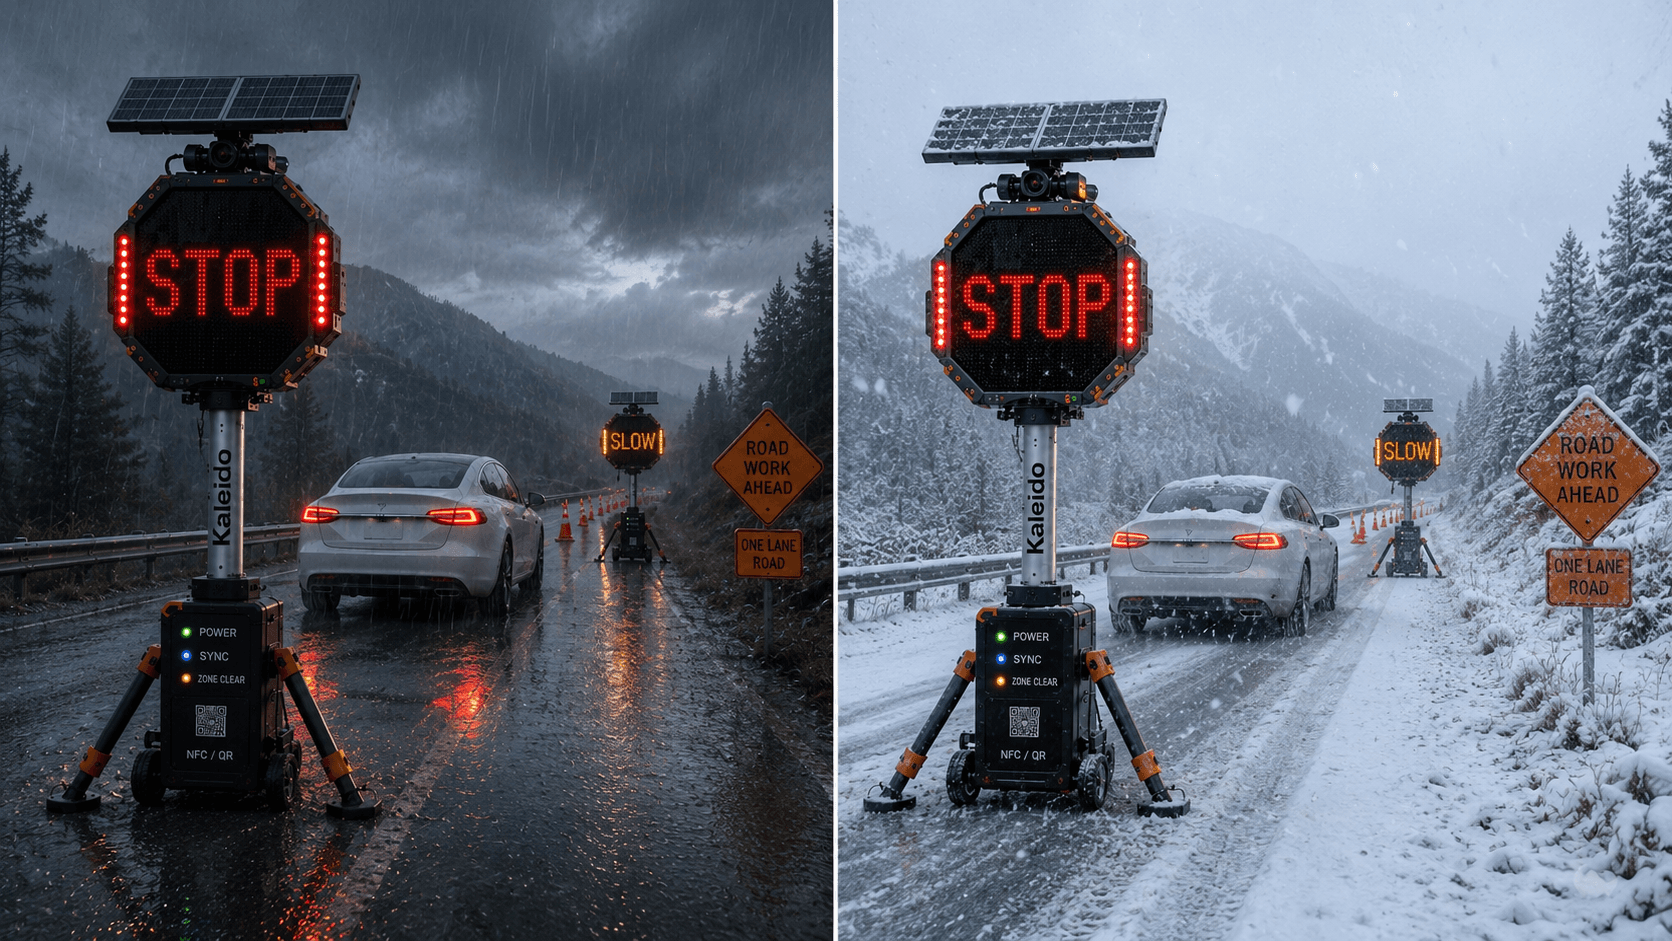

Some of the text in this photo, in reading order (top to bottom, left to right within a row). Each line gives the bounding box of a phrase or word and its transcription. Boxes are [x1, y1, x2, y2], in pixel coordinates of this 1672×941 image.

[147, 249, 300, 316] STOP
[963, 274, 1110, 338] STOP
[610, 432, 656, 450] SLOW
[746, 440, 789, 456] ROAD
[1560, 436, 1614, 454] ROAD
[1384, 441, 1432, 461] SLOW
[743, 460, 791, 476] WORK
[1557, 461, 1617, 480] WORK
[743, 480, 793, 495] AHEAD
[1556, 486, 1619, 503] AHEAD
[212, 449, 232, 545] Kaleido
[1026, 462, 1045, 554] Kaleido
[741, 538, 797, 552] ONE LANE
[753, 556, 785, 570] ROAD
[1554, 558, 1624, 574] ONE LANE
[1569, 579, 1609, 595] ROAD
[199, 627, 237, 638] POWER
[1013, 631, 1049, 642] POWER
[199, 651, 229, 662] SYNC
[1013, 655, 1042, 664] SYNC
[197, 674, 245, 684] ZONE CLEAR
[1011, 677, 1058, 687] ZONE CLEAR
[186, 750, 208, 760] NFC
[218, 750, 233, 761] QR
[1000, 750, 1021, 760] NFC
[1031, 750, 1046, 761] QR
